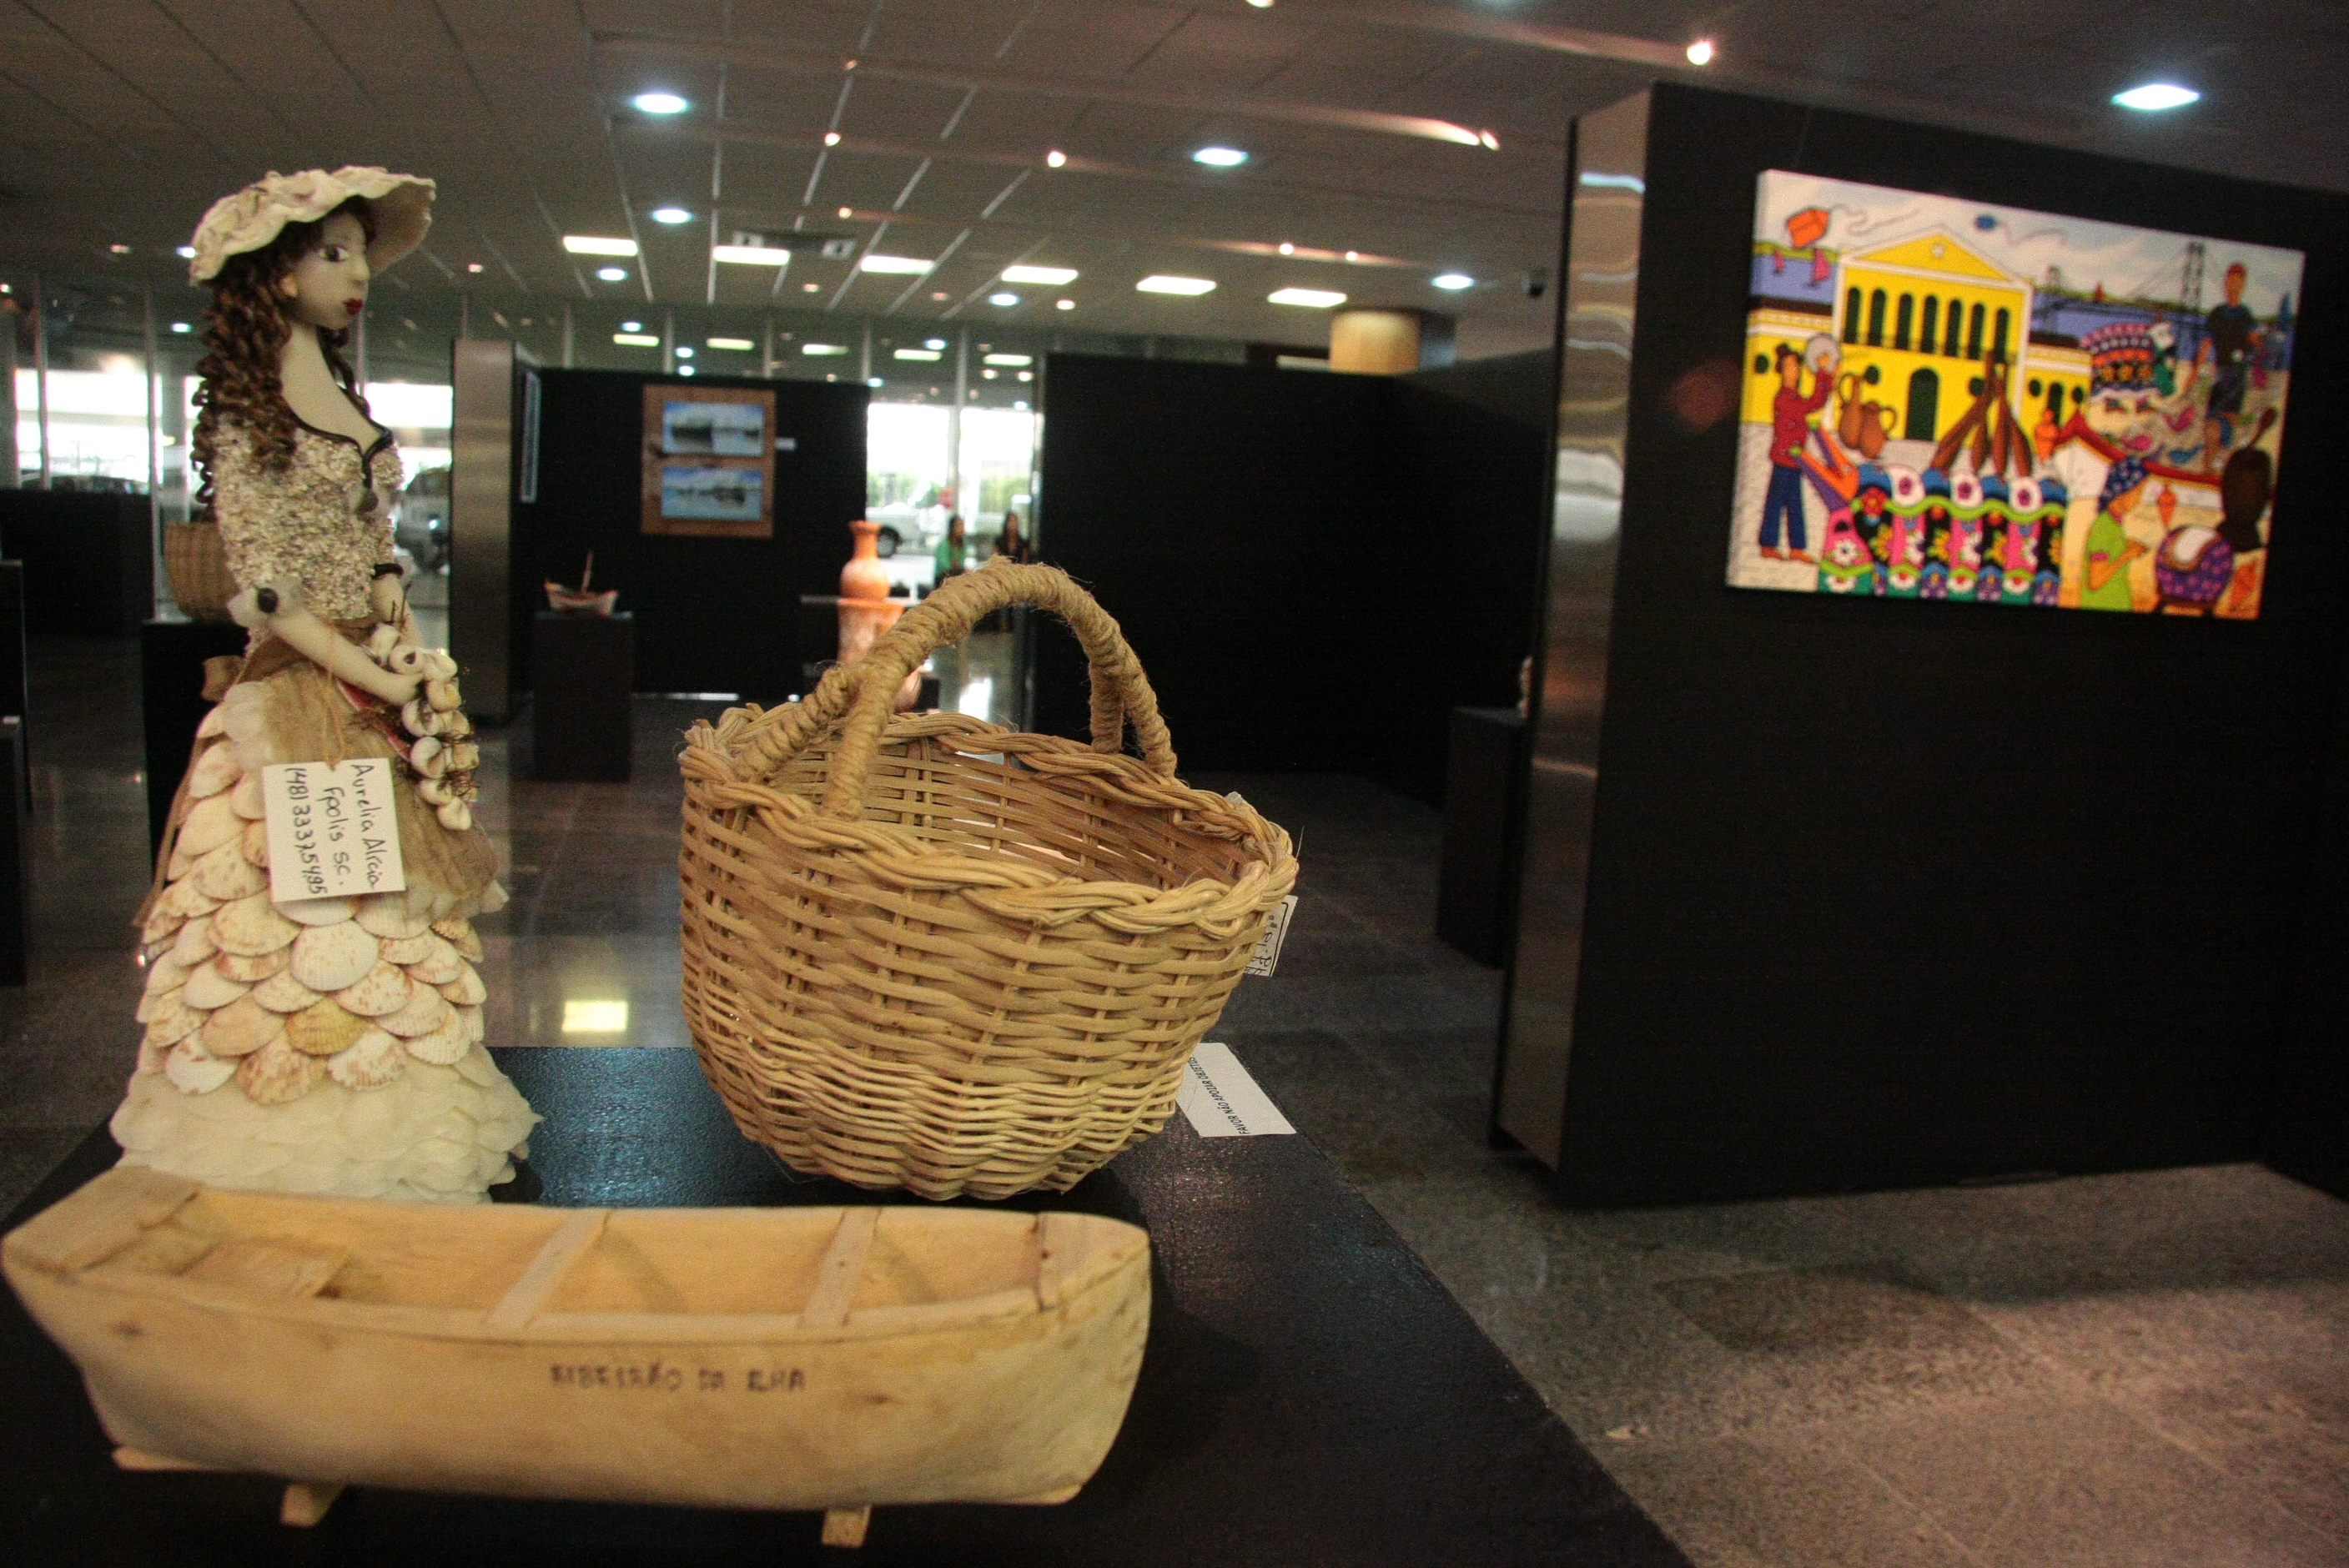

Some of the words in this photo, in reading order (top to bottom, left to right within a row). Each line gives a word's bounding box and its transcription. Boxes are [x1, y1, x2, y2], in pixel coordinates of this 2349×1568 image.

[350, 764, 382, 832] Aurelia
[1202, 1080, 1225, 1102] APOIAR
[1218, 1102, 1235, 1115] NÃO
[1228, 1115, 1250, 1134] FAVOR
